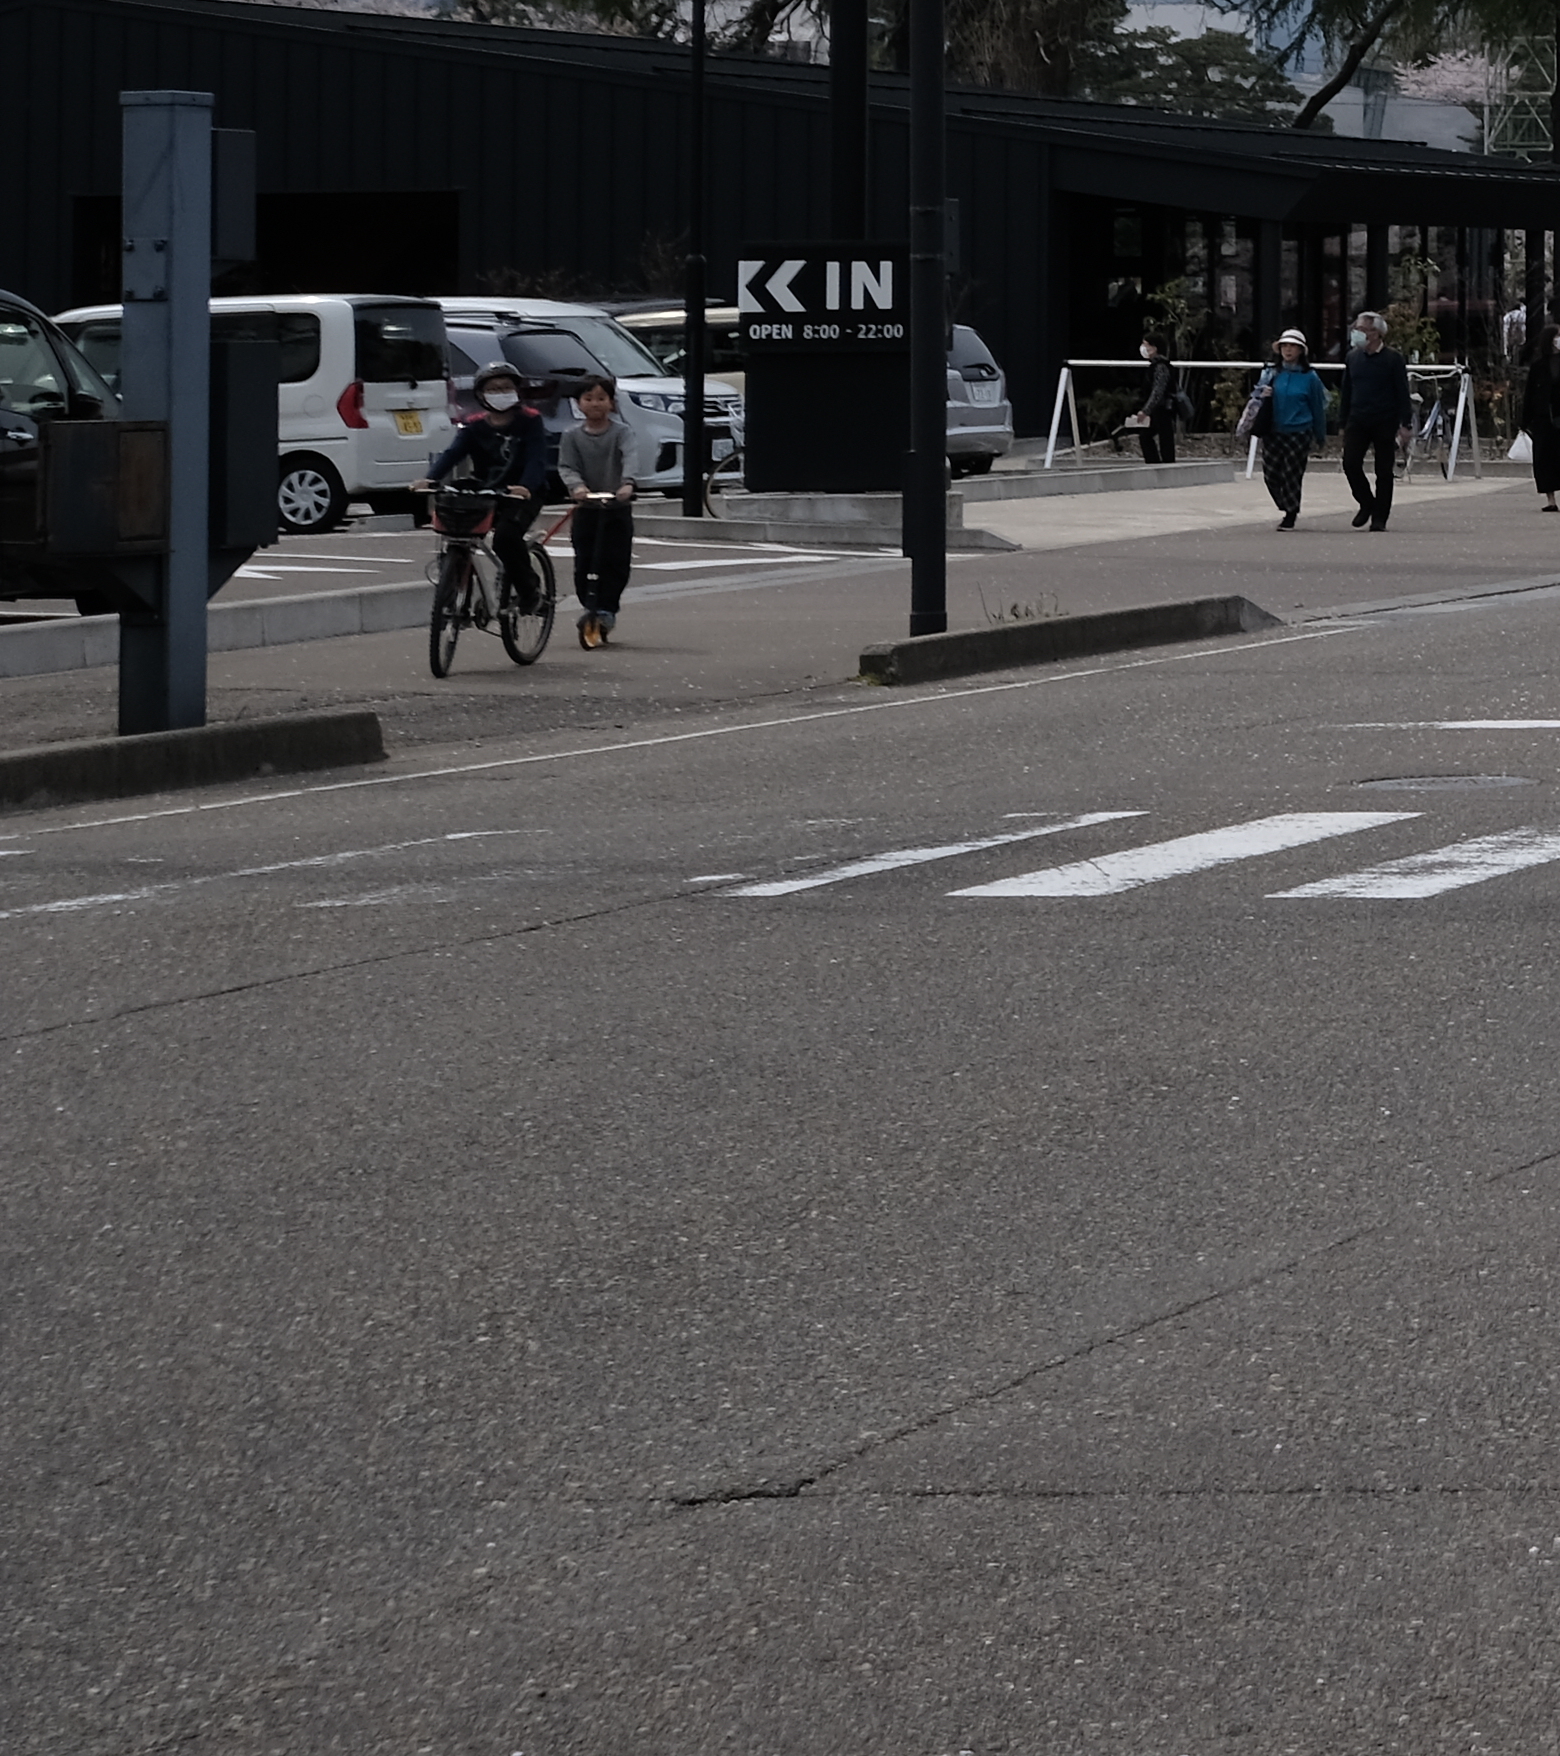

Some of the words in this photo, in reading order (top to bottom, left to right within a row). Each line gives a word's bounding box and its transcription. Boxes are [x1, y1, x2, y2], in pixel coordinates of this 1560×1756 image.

[826, 260, 893, 310] IN
[749, 324, 794, 340] OPEN
[802, 324, 840, 339] 8:00
[856, 323, 904, 339] 22:00
